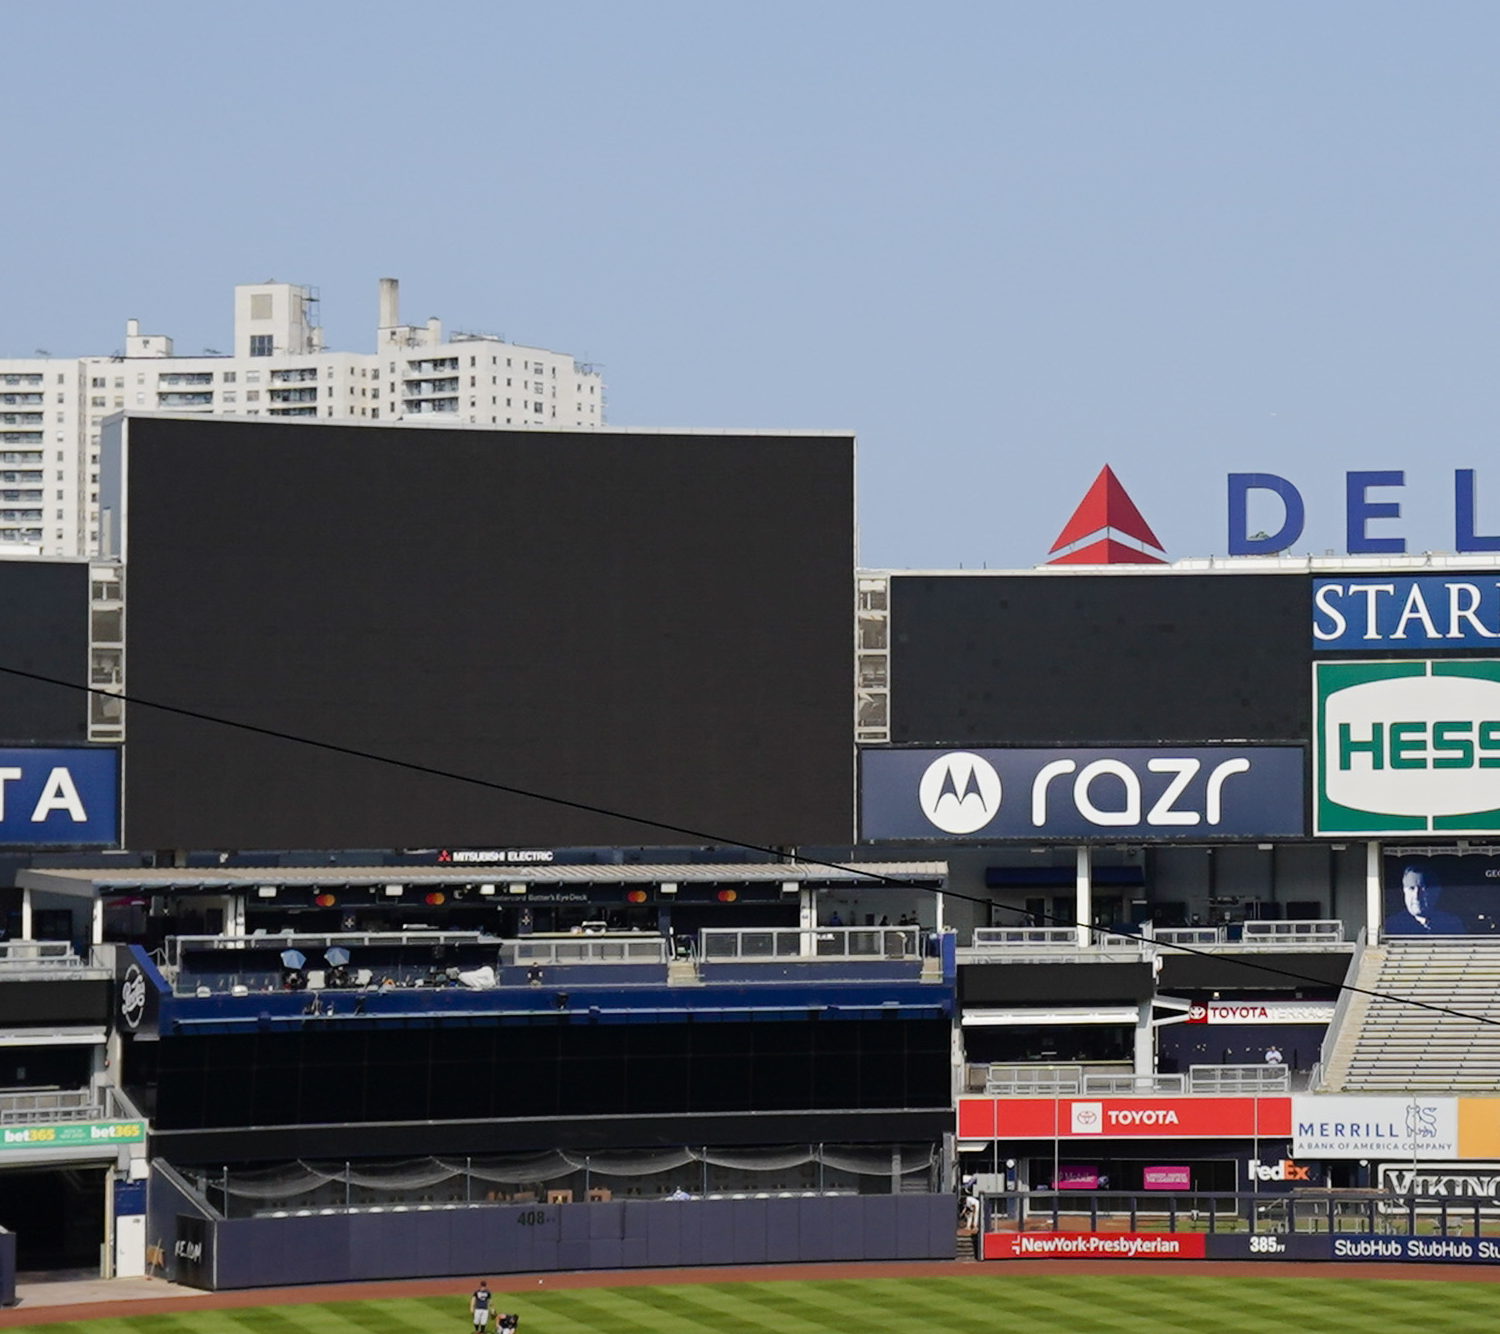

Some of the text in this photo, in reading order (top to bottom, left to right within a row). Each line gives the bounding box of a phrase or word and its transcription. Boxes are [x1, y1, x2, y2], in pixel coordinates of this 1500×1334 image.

[1032, 758, 1250, 827] razr
[453, 851, 554, 862] MITSUBISHI ELECTRIC
[1210, 1007, 1268, 1018] TOYOTA
[1108, 1110, 1179, 1125] TOYOTA
[5, 1129, 56, 1143] bet365
[91, 1125, 141, 1139] bet365
[1298, 1123, 1399, 1138] MERRILL
[1307, 1142, 1335, 1151] BANK
[1337, 1142, 1350, 1151] OF
[1352, 1142, 1400, 1151] AMERICA
[1401, 1142, 1453, 1151] COMPANY
[1248, 1160, 1310, 1181] FedEx
[1334, 1239, 1402, 1258] StubHub
[1407, 1240, 1473, 1259] StubHub
